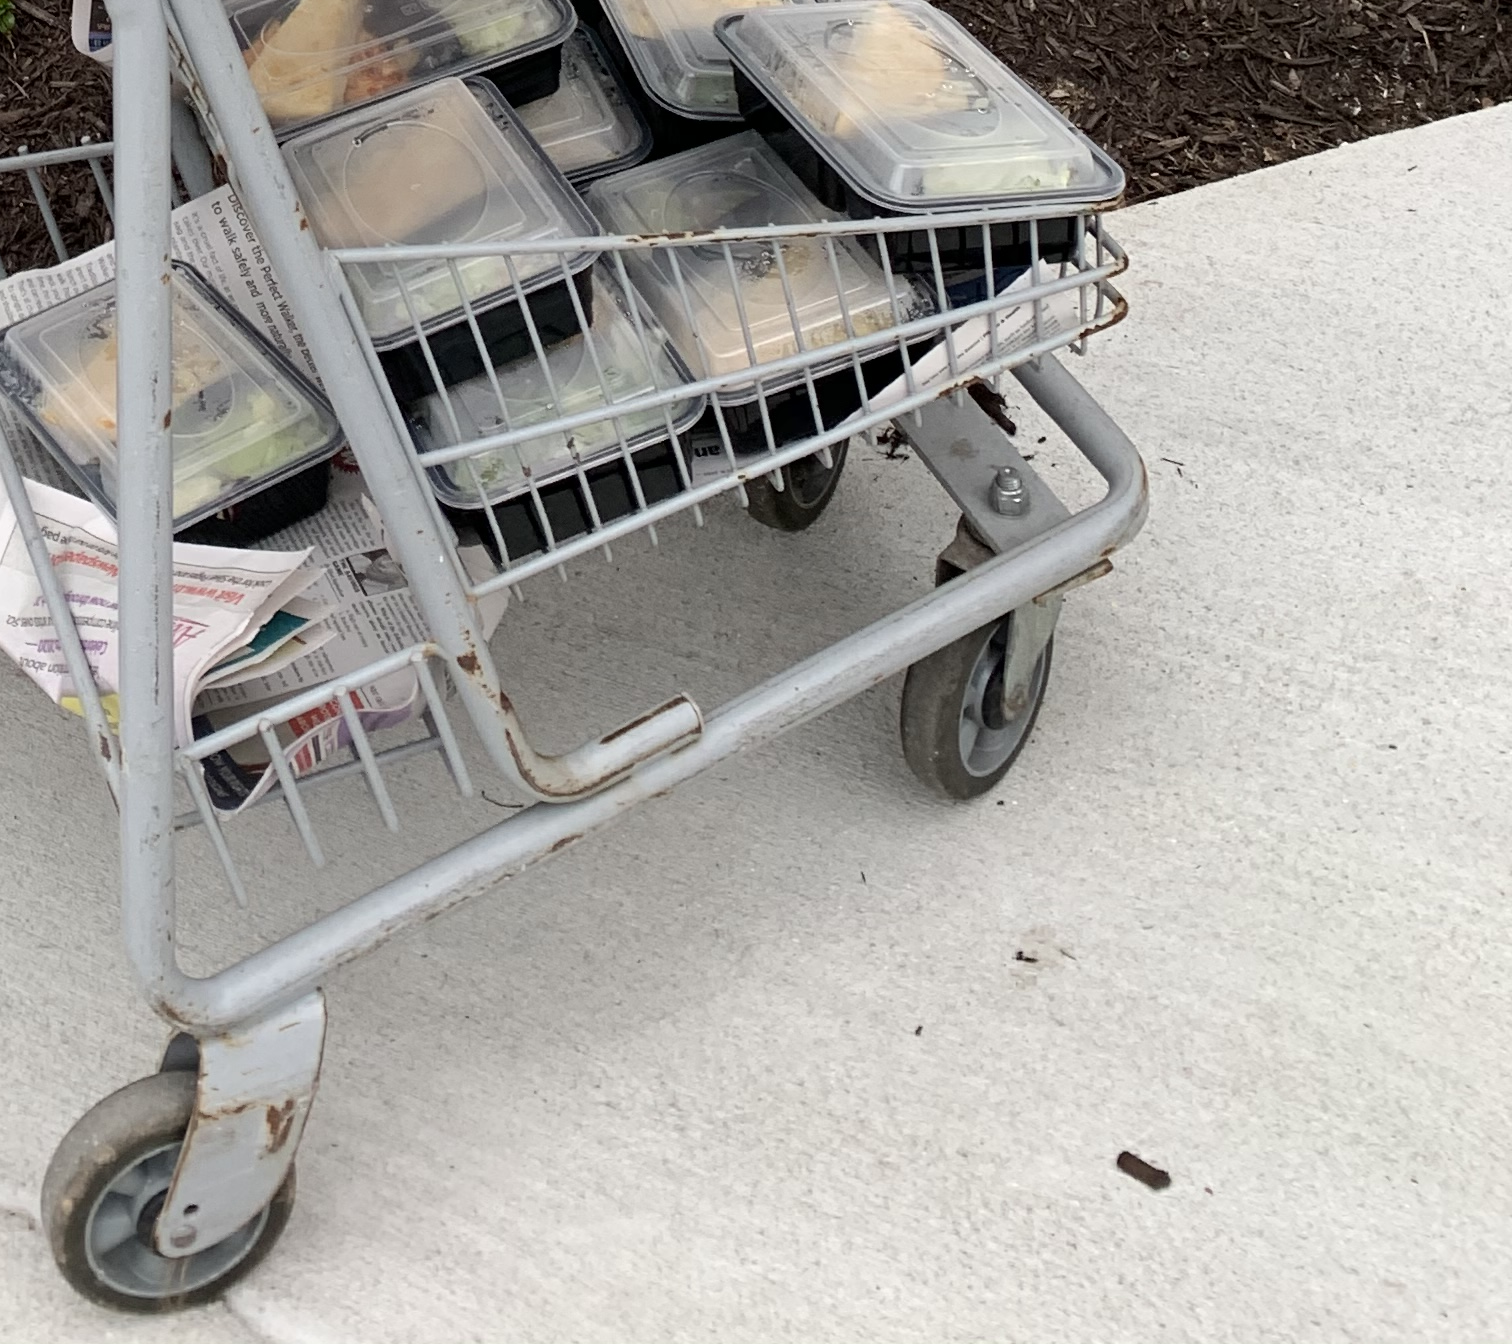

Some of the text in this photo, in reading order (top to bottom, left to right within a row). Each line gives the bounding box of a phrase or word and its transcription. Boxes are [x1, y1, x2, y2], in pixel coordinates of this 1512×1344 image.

[211, 200, 223, 216] to
[218, 216, 238, 246] walk
[231, 246, 252, 278] safely
[245, 279, 263, 298] and
[252, 244, 265, 265] the
[261, 265, 283, 302] Perfect
